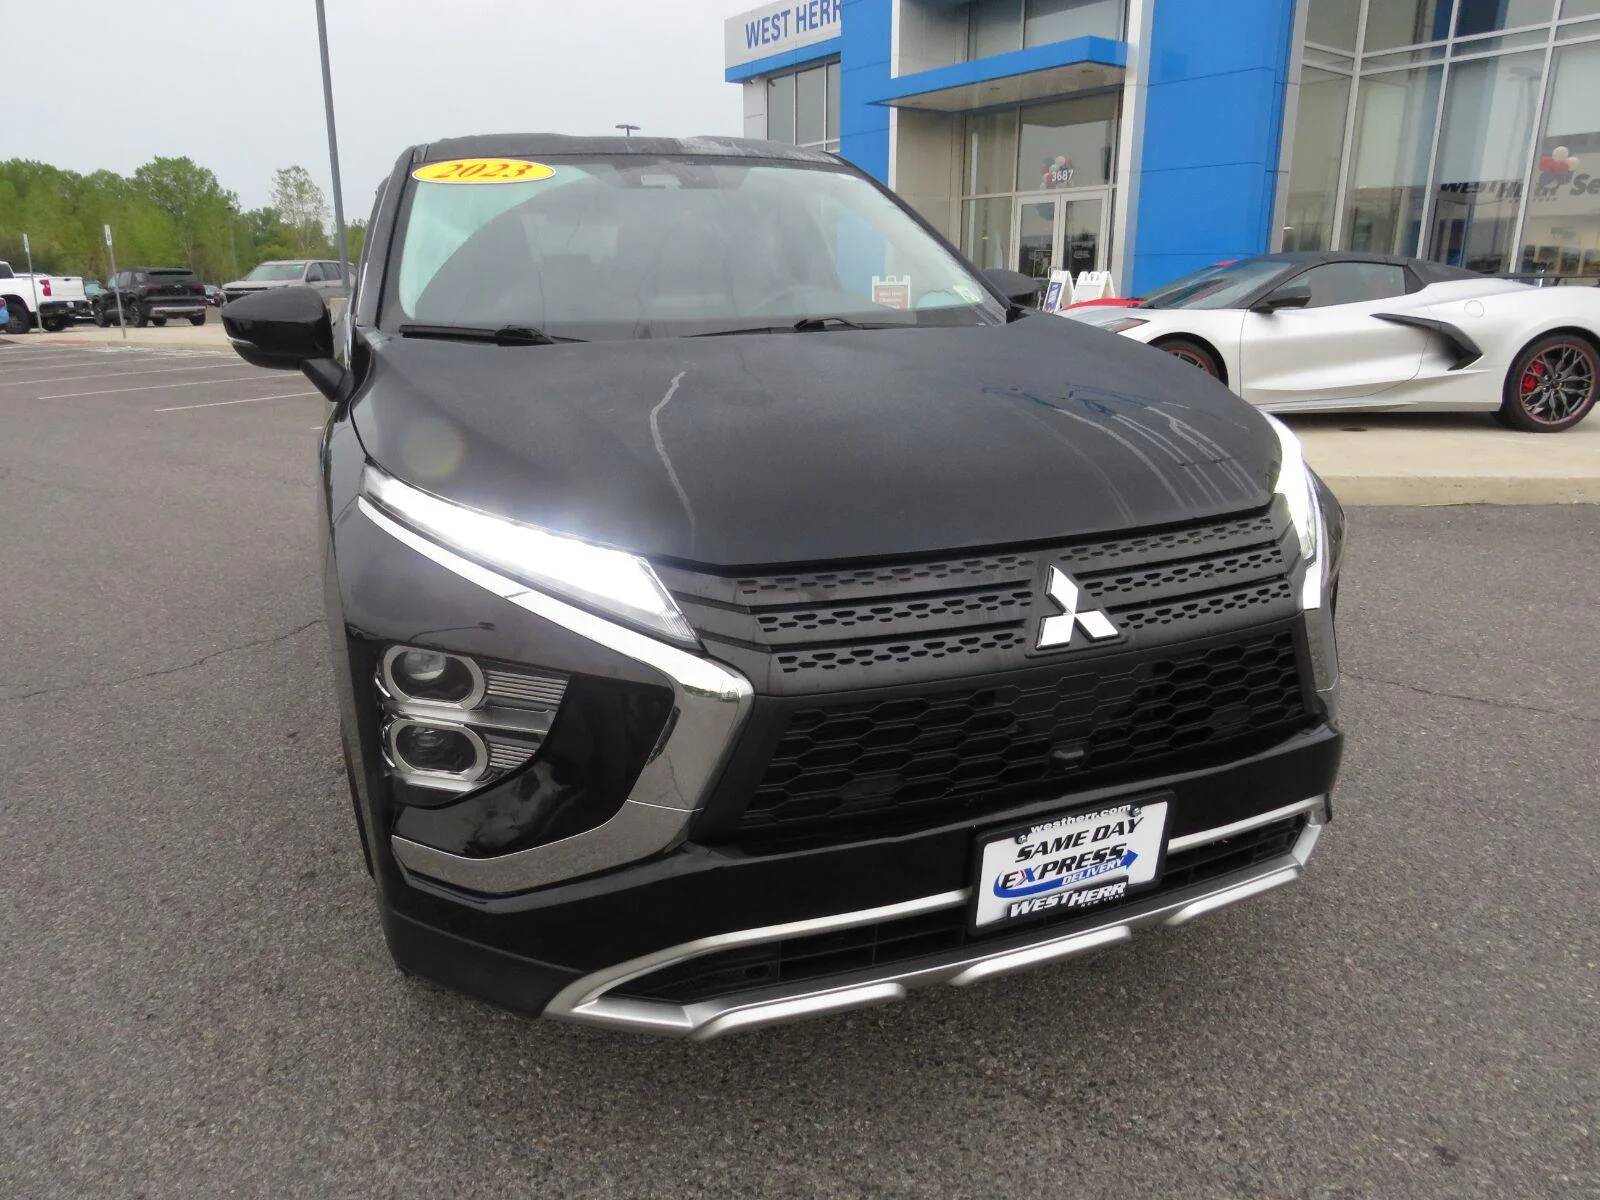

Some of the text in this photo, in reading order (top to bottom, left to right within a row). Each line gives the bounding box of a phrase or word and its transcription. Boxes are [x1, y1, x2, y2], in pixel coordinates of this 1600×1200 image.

[745, 9, 791, 48] WEST
[431, 163, 533, 179] 2023
[1051, 169, 1074, 182] 3687
[1030, 804, 1131, 833] westherr.com
[1014, 816, 1144, 863] SAME DAY
[1001, 842, 1127, 889] EXPRESS
[1061, 857, 1125, 886] DELIVERY
